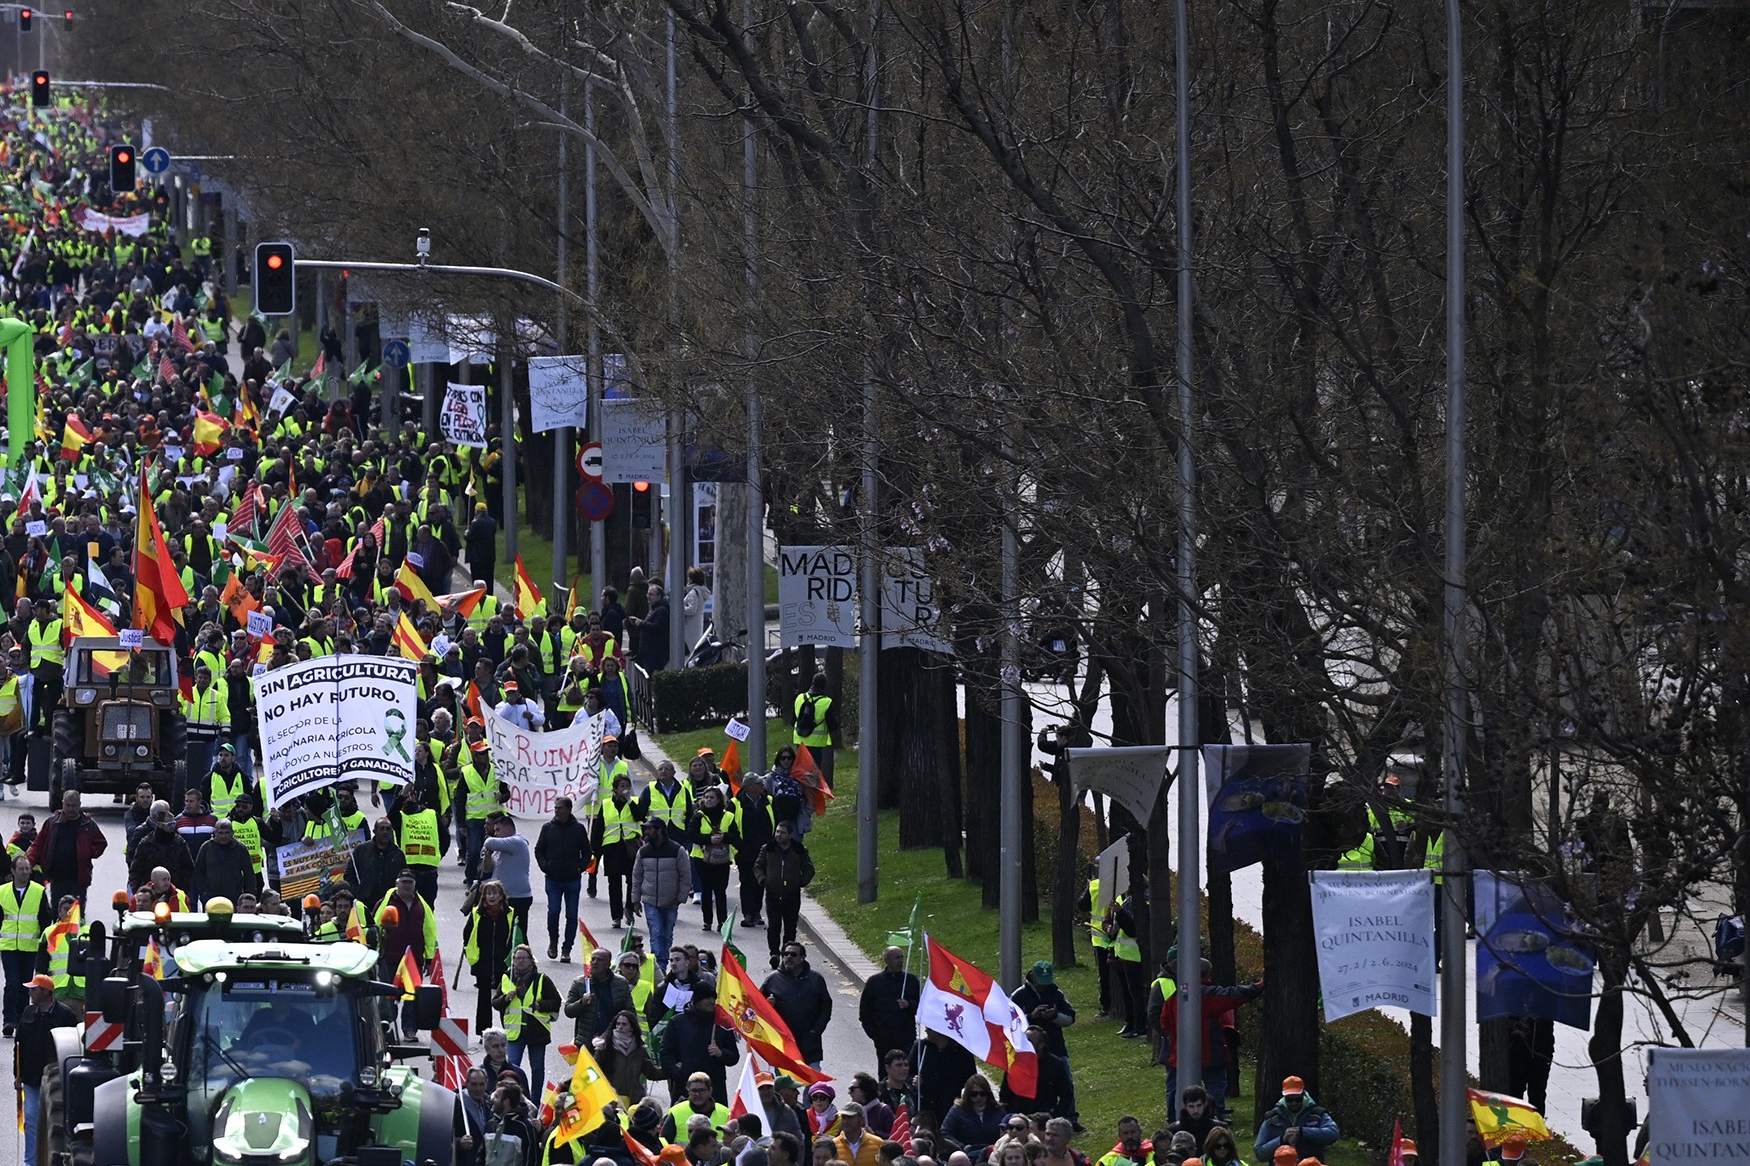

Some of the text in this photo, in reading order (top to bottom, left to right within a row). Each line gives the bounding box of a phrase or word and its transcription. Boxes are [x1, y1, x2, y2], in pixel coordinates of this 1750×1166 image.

[781, 553, 853, 577] MAD
[807, 577, 853, 602] RID
[783, 602, 817, 629] ES
[806, 634, 836, 643] MADRID
[261, 663, 416, 698] SIN AGRICULTURA,
[264, 686, 400, 723] NO HAY FUTURO.
[267, 716, 343, 745] EL SECTOR DE LA
[271, 769, 283, 782] EN
[313, 751, 321, 760] A
[323, 743, 374, 760] NUESTROS
[514, 734, 590, 768] RUINA
[342, 762, 349, 771] Y
[350, 759, 414, 781] GANADEROS
[544, 766, 581, 785] TU
[282, 850, 292, 860] LA
[1348, 915, 1403, 927] ISABEL
[1321, 931, 1430, 951] QUINTANILLA
[1364, 992, 1407, 1005] MADRID
[1693, 1119, 1750, 1136] ISABE
